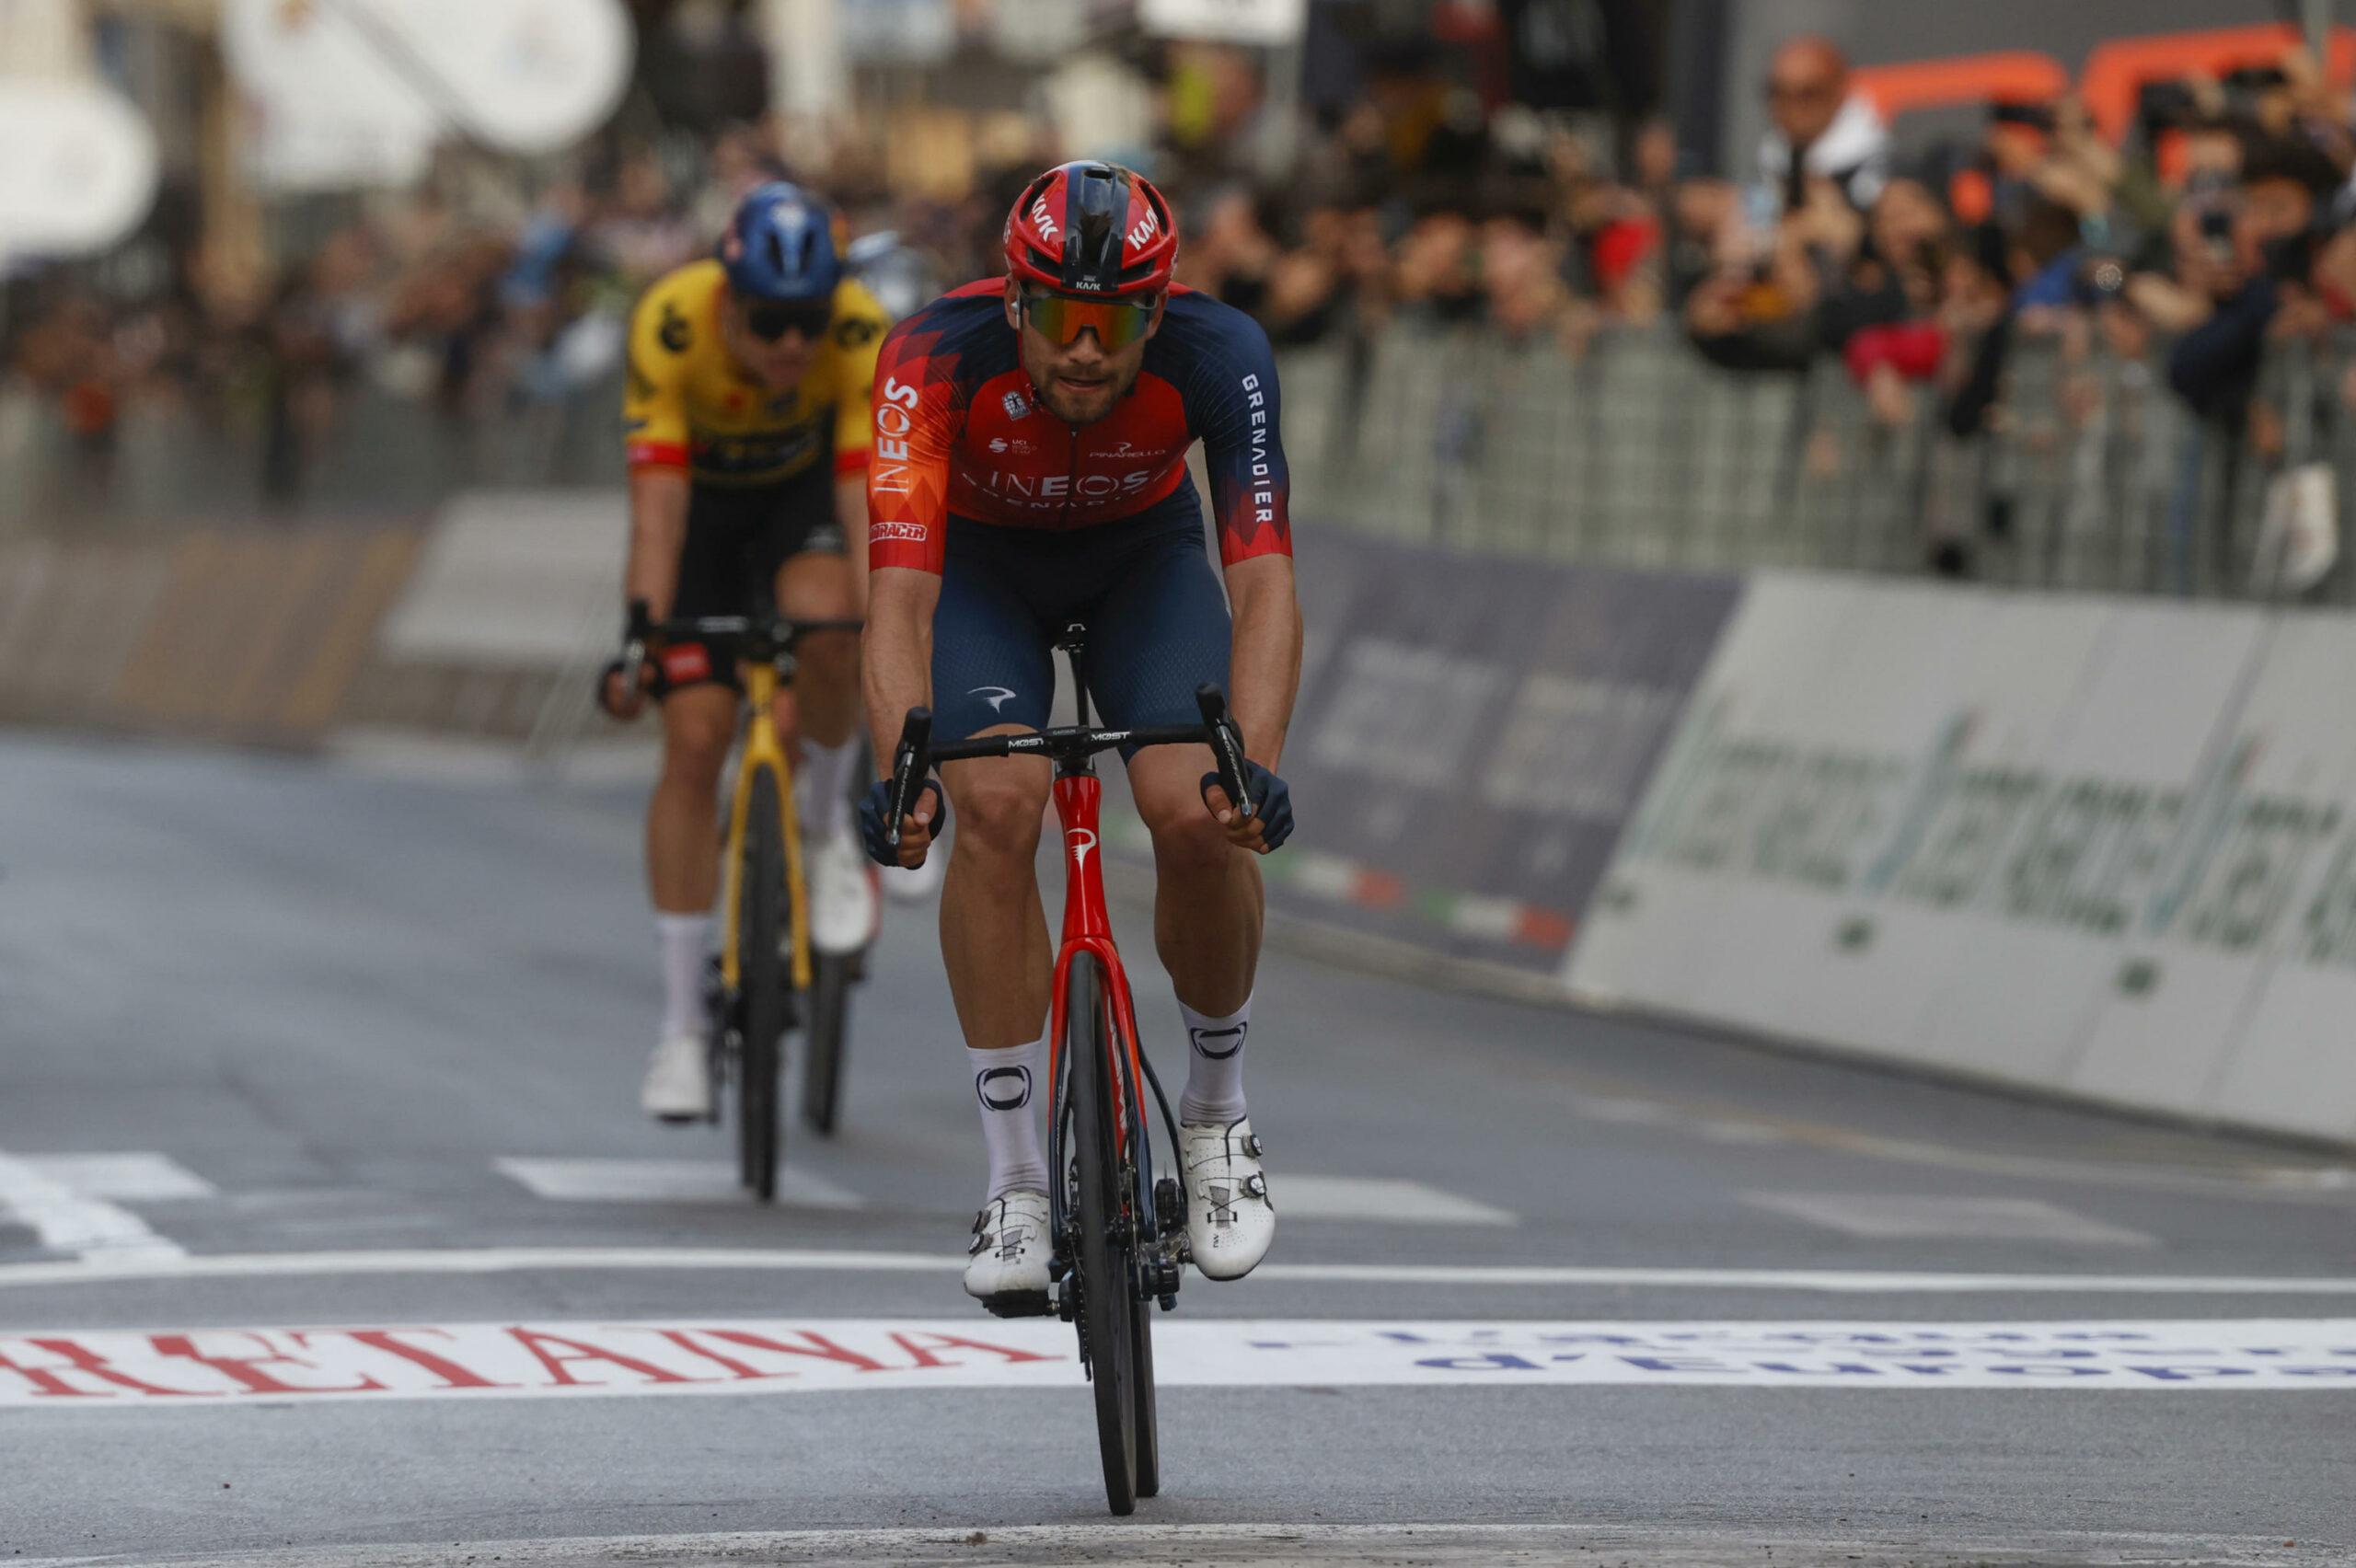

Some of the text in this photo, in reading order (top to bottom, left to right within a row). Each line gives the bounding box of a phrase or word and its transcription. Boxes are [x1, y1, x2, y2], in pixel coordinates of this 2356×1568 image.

[1076, 282, 1101, 292] KASK
[873, 376, 918, 494] INEOS
[1089, 449, 1166, 458] PINARELLO
[1242, 374, 1273, 524] GRENADIER
[990, 470, 1149, 497] INEOS
